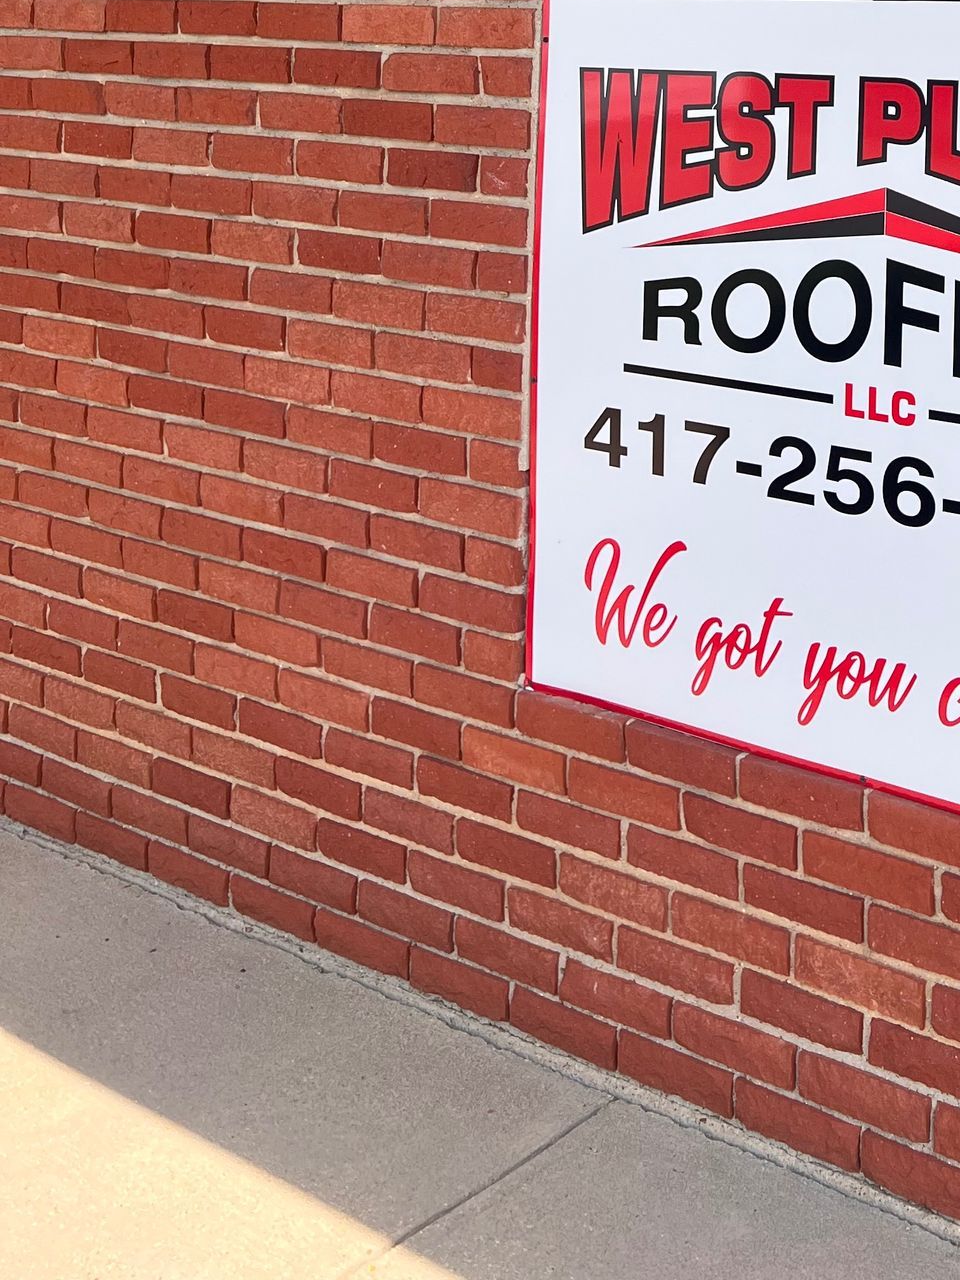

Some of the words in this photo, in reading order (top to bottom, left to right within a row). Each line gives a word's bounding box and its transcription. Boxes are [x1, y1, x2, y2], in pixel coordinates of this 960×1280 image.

[579, 67, 834, 234] WEST
[844, 382, 917, 427] LLC
[584, 537, 687, 648] We
[690, 597, 793, 696] got
[798, 641, 918, 725] you
